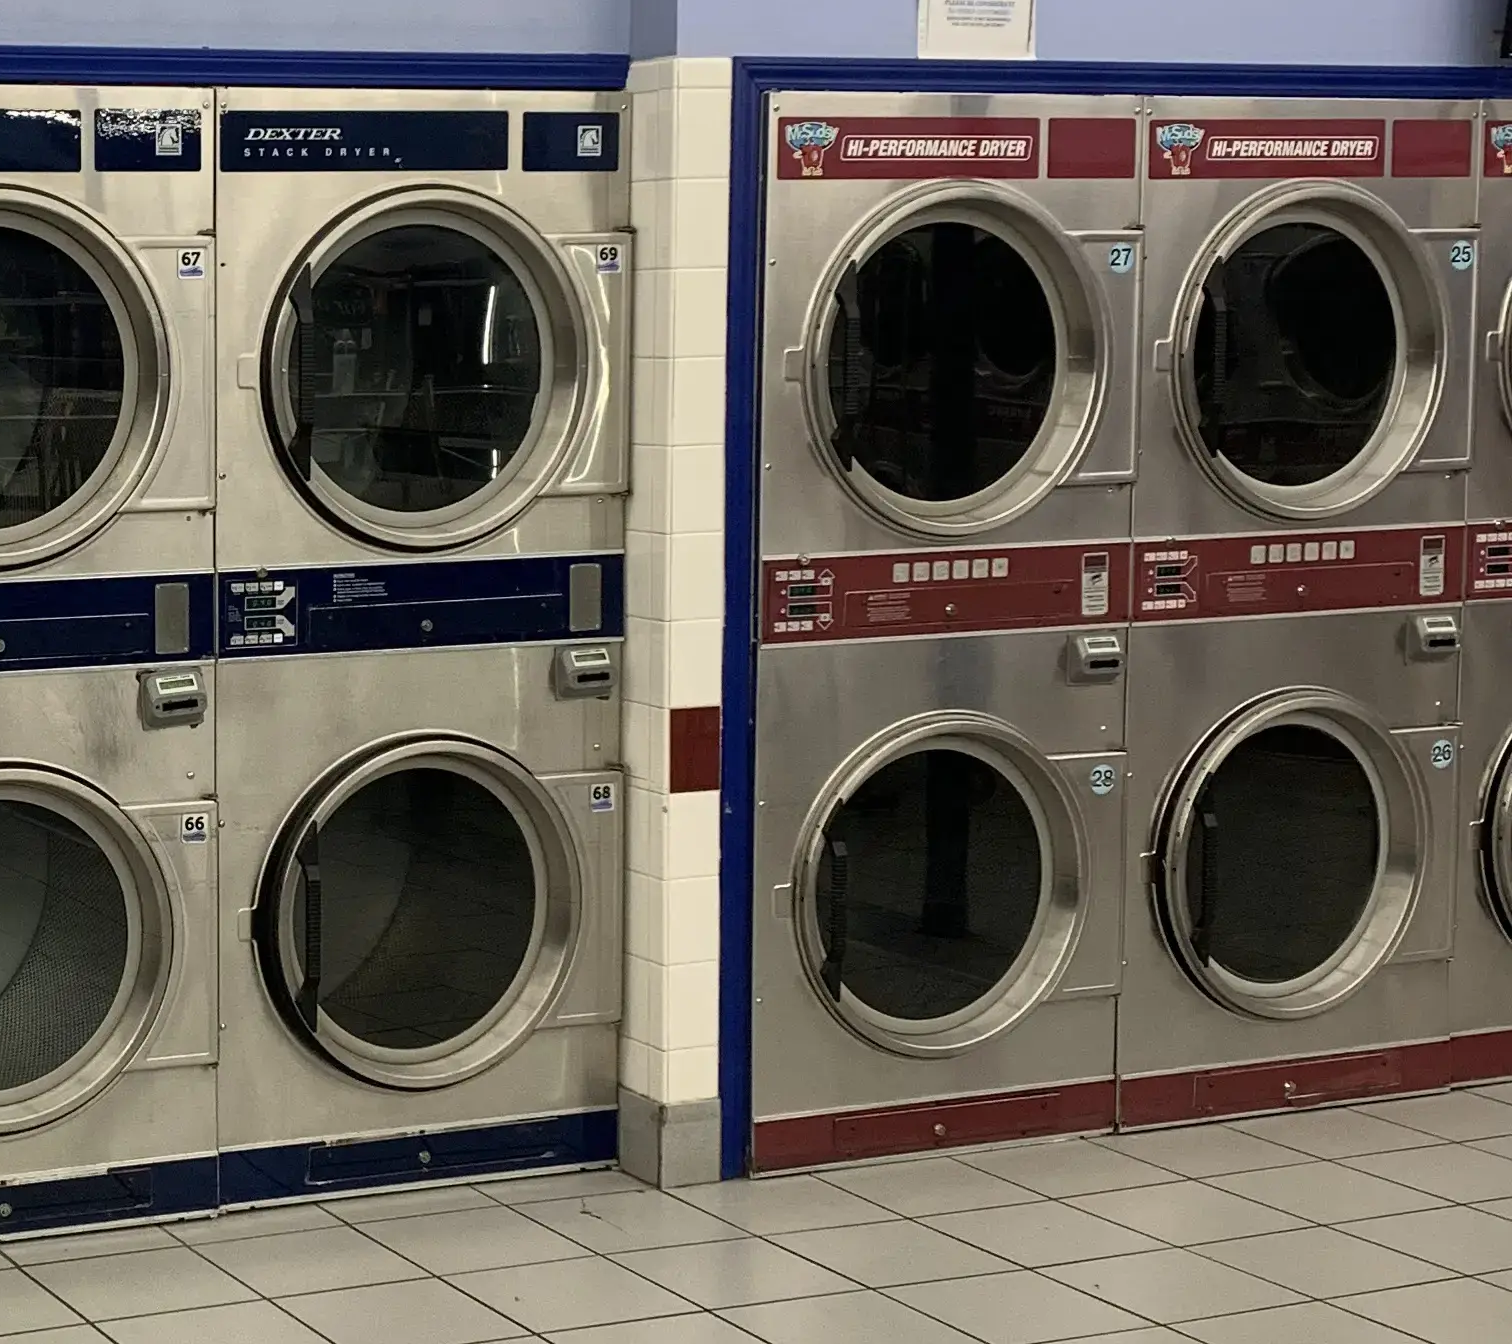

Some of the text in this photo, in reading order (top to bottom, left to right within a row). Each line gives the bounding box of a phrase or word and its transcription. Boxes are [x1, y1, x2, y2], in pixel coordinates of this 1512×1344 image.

[244, 127, 341, 141] DEXTER
[244, 147, 390, 157] STACK DRYER
[846, 138, 1027, 158] HI-PERFORMANCE DRYER
[1211, 139, 1374, 157] HI-PERFORMANCE DRYER
[181, 251, 201, 266] 67
[599, 247, 618, 262] 69
[1110, 248, 1131, 267] 27
[1451, 246, 1471, 263] 25
[1432, 744, 1452, 763] 26
[1092, 770, 1114, 787] 28
[592, 786, 611, 800] 68
[184, 816, 204, 831] 66
